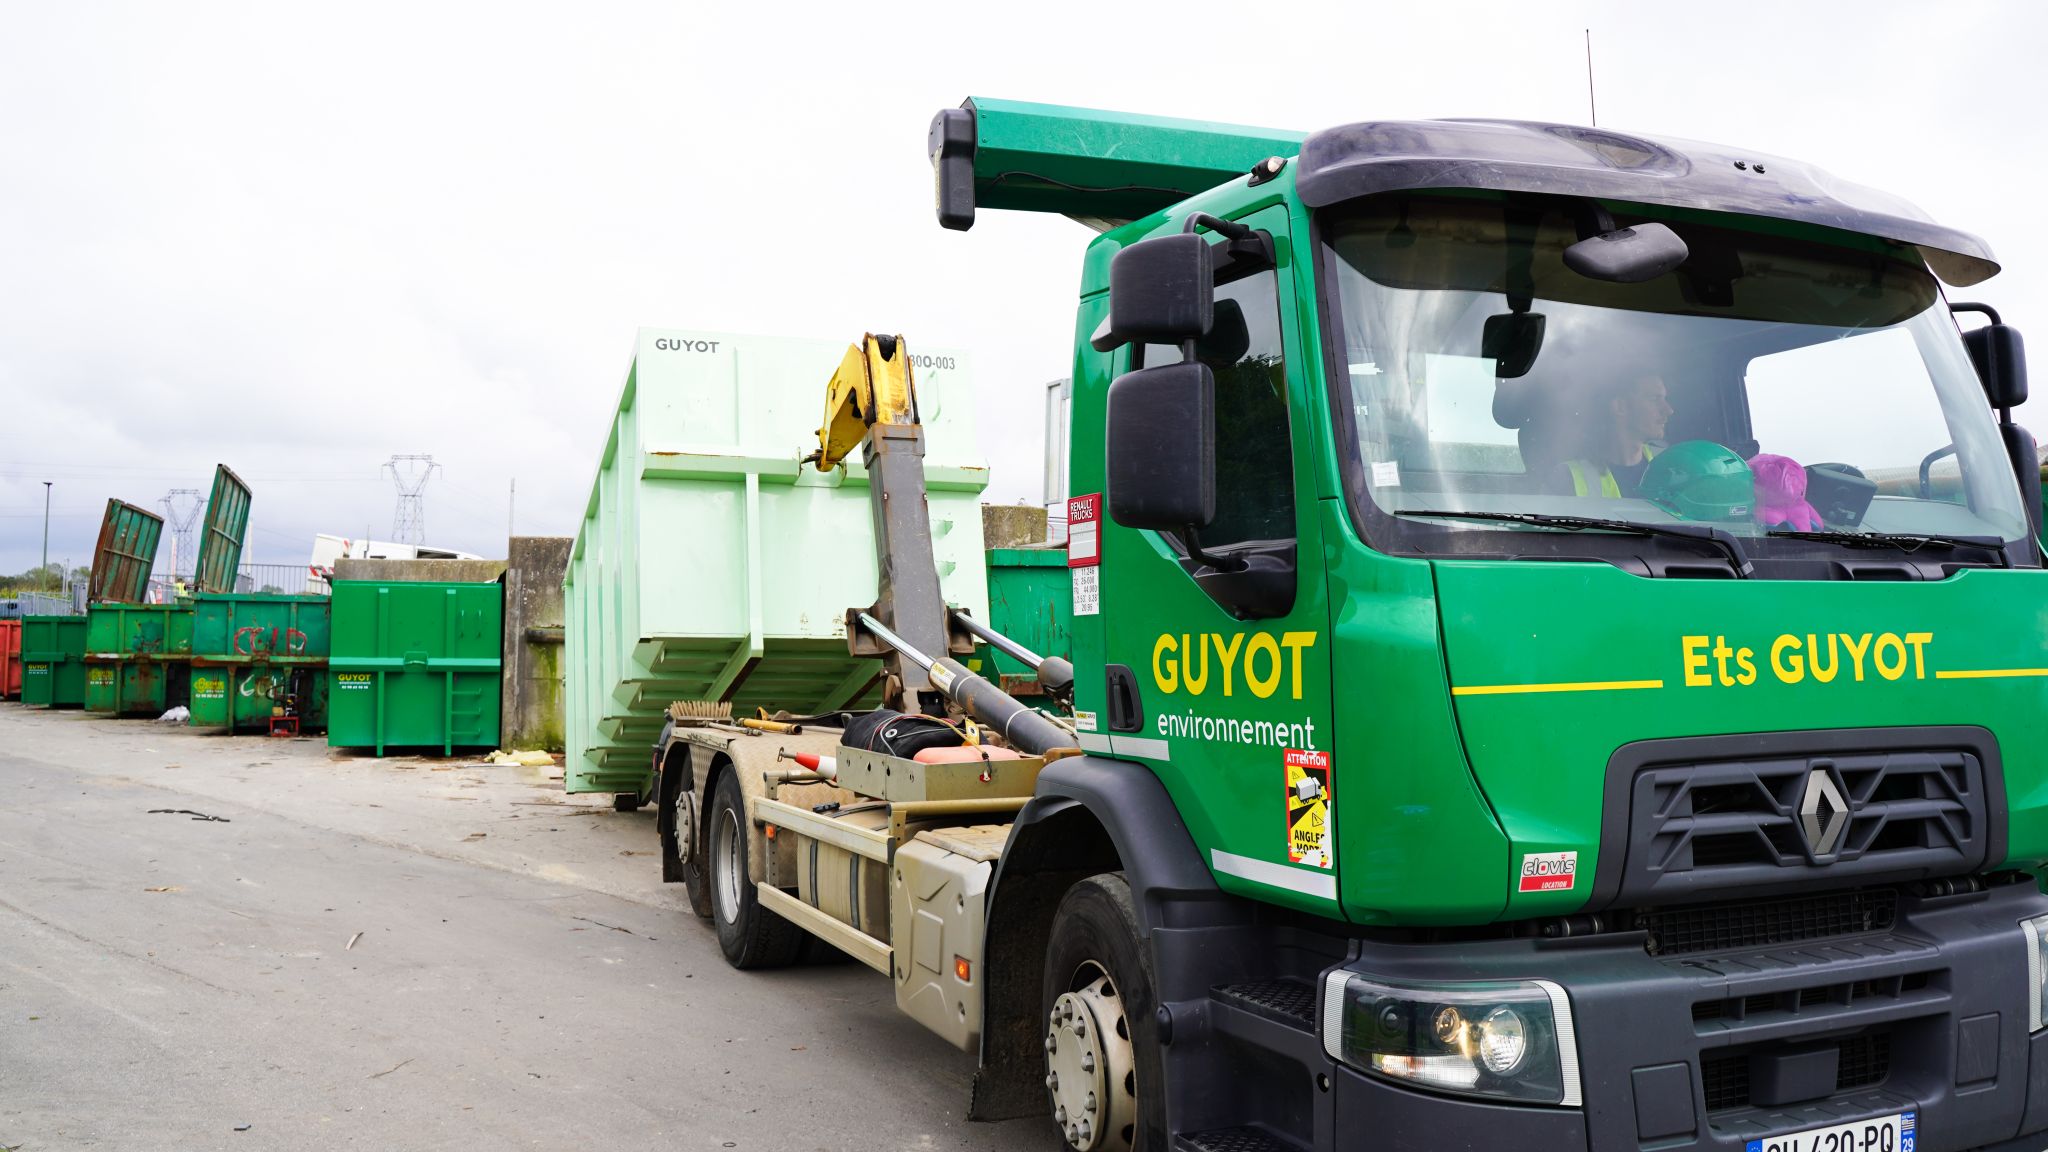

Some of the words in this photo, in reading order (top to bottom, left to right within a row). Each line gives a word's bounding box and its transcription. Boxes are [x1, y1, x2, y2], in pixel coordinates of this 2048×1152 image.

[655, 338, 719, 353] GUYOT
[1070, 499, 1093, 511] RENAULT
[1070, 508, 1093, 521] TRUCKS
[1152, 631, 1317, 700] GUYOT
[1682, 635, 1757, 687] Ets
[1770, 632, 1933, 684] GUYOT
[338, 673, 372, 681] GUYOT
[1157, 708, 1315, 749] environnement
[1287, 752, 1327, 766] ATTENTION
[1523, 857, 1575, 876] clovis
[1541, 881, 1568, 889] LOCATION
[1902, 1137, 1914, 1152] 29
